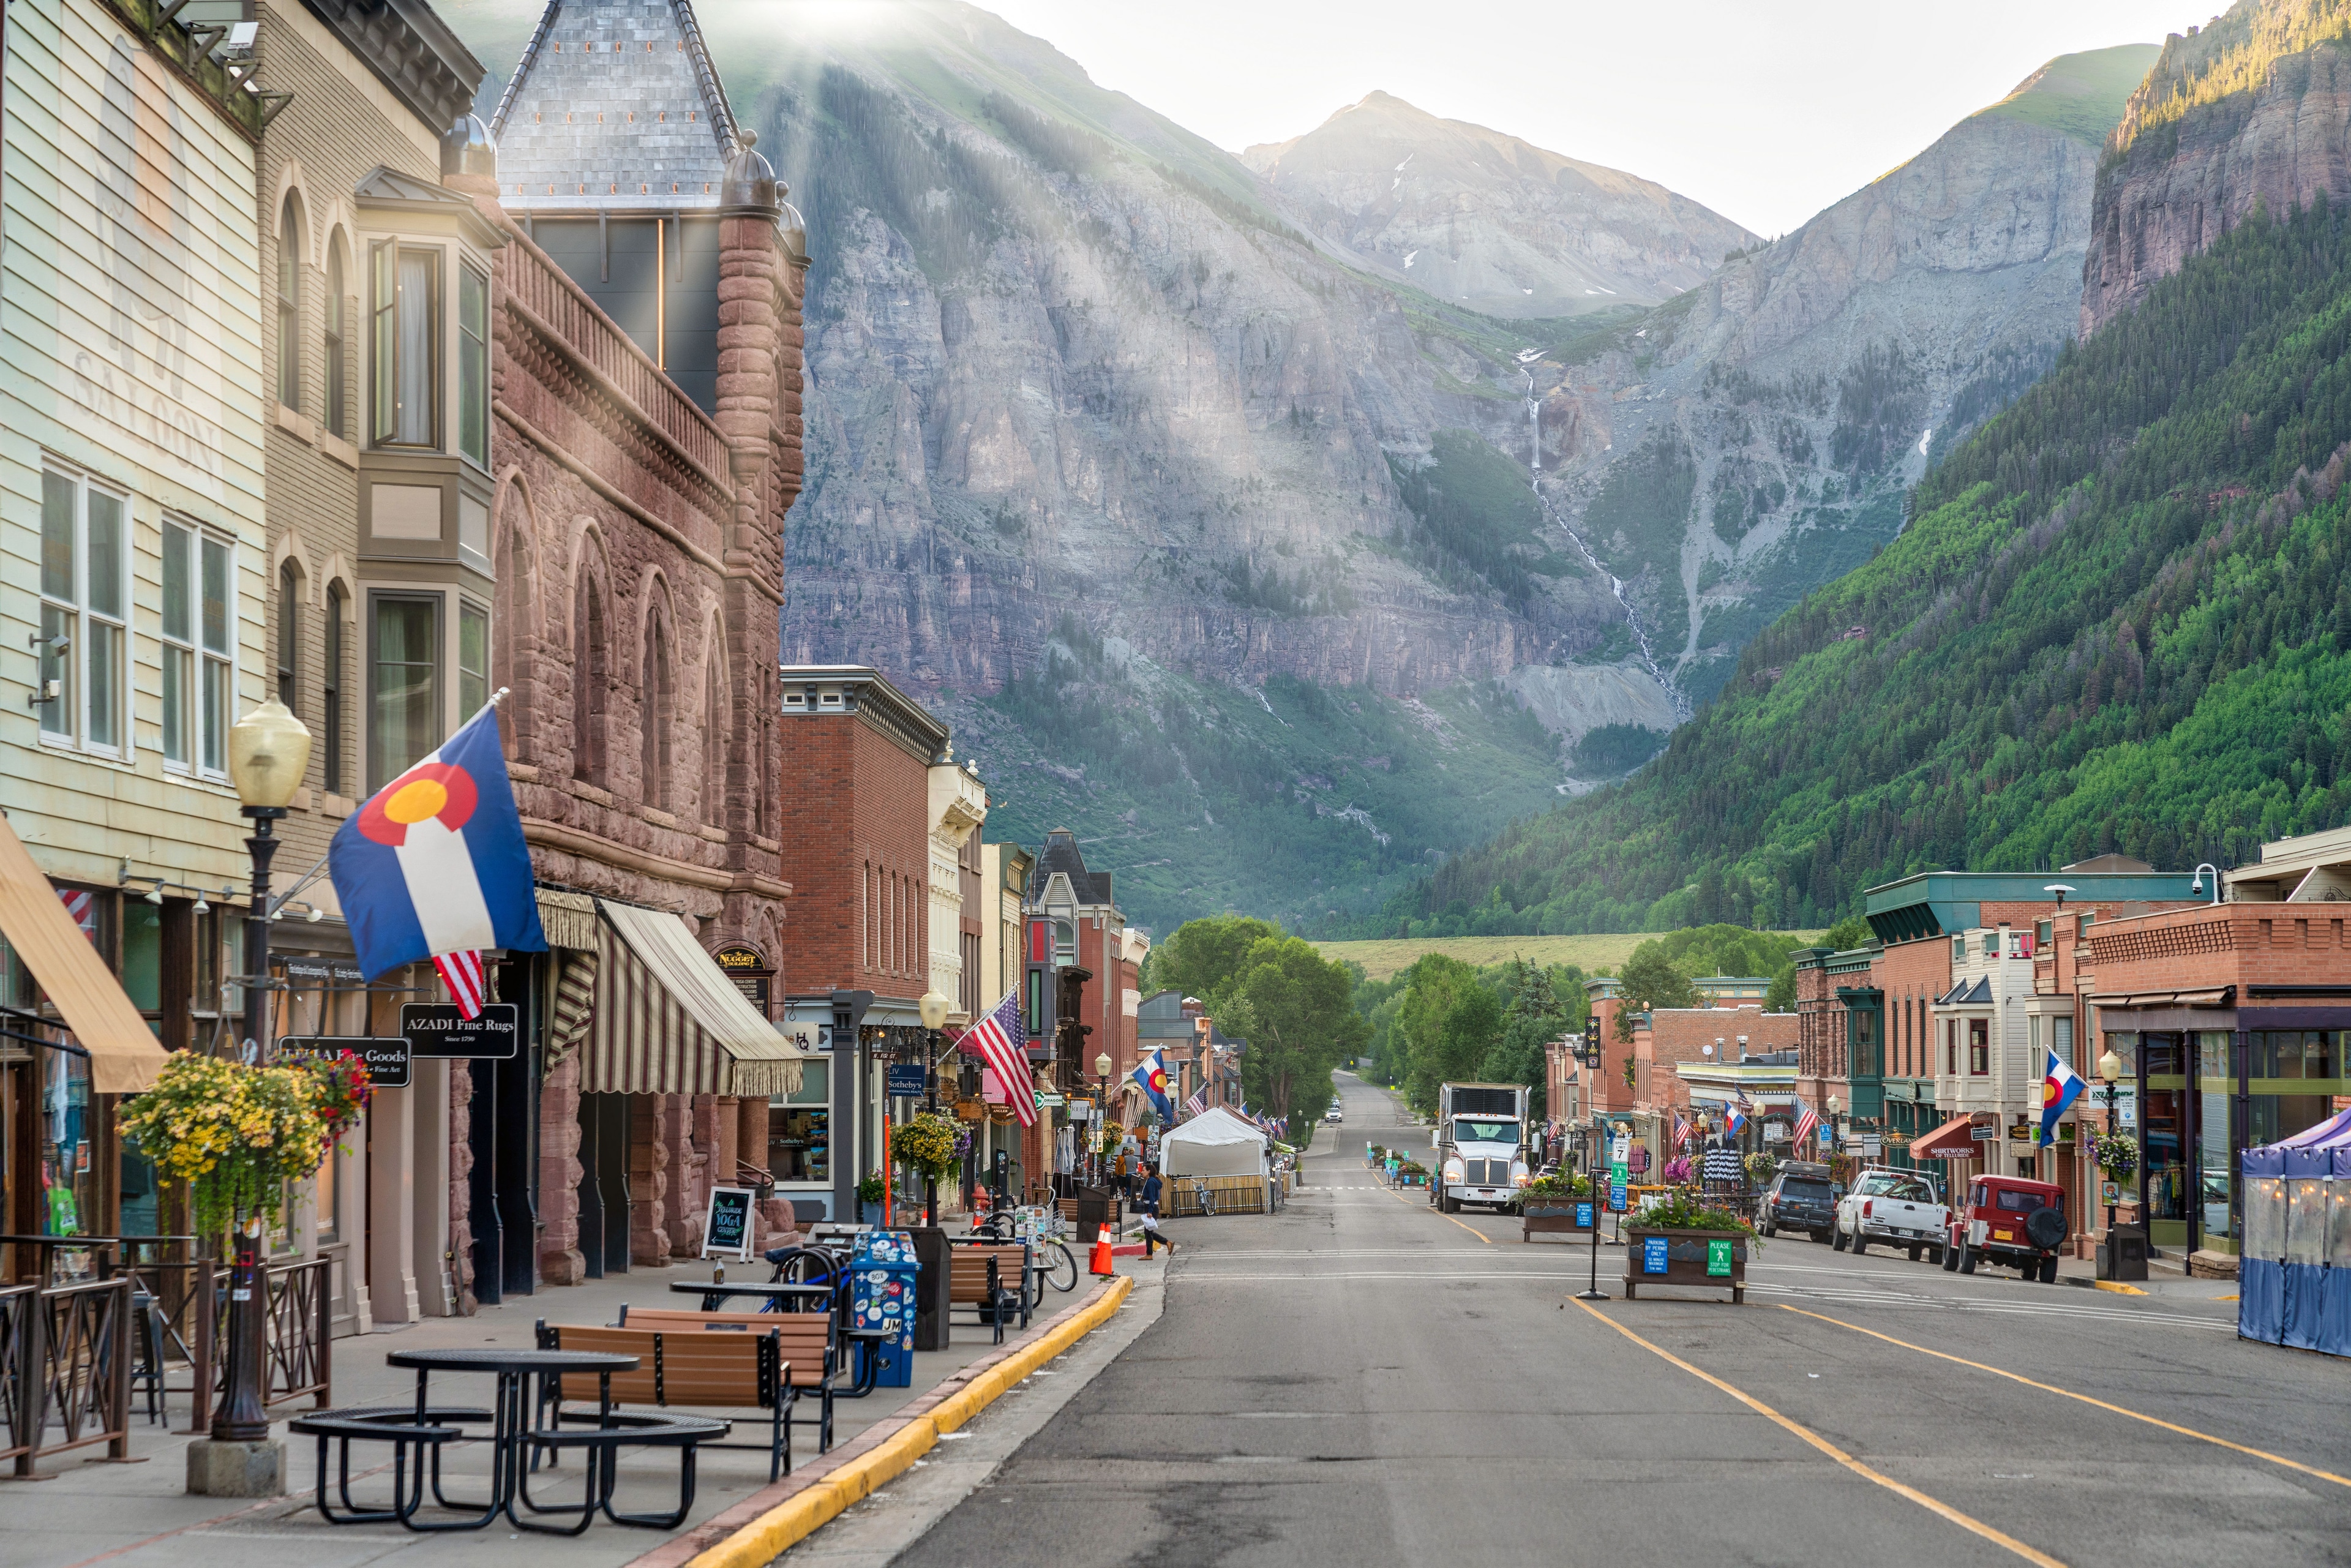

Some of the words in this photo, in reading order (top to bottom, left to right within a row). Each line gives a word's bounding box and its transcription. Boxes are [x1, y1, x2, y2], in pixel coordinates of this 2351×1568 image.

[73, 351, 216, 489] SALOON
[719, 953, 756, 969] NUGGET
[407, 1019, 454, 1030] AZADI
[456, 1019, 483, 1030] Fine
[485, 1019, 515, 1033] Rugs
[366, 1049, 407, 1062] Goods
[888, 1081, 922, 1089] Sotheby's
[1618, 1150, 1624, 1158] 7
[716, 1214, 740, 1227] YOGA
[884, 1319, 901, 1332] JM
